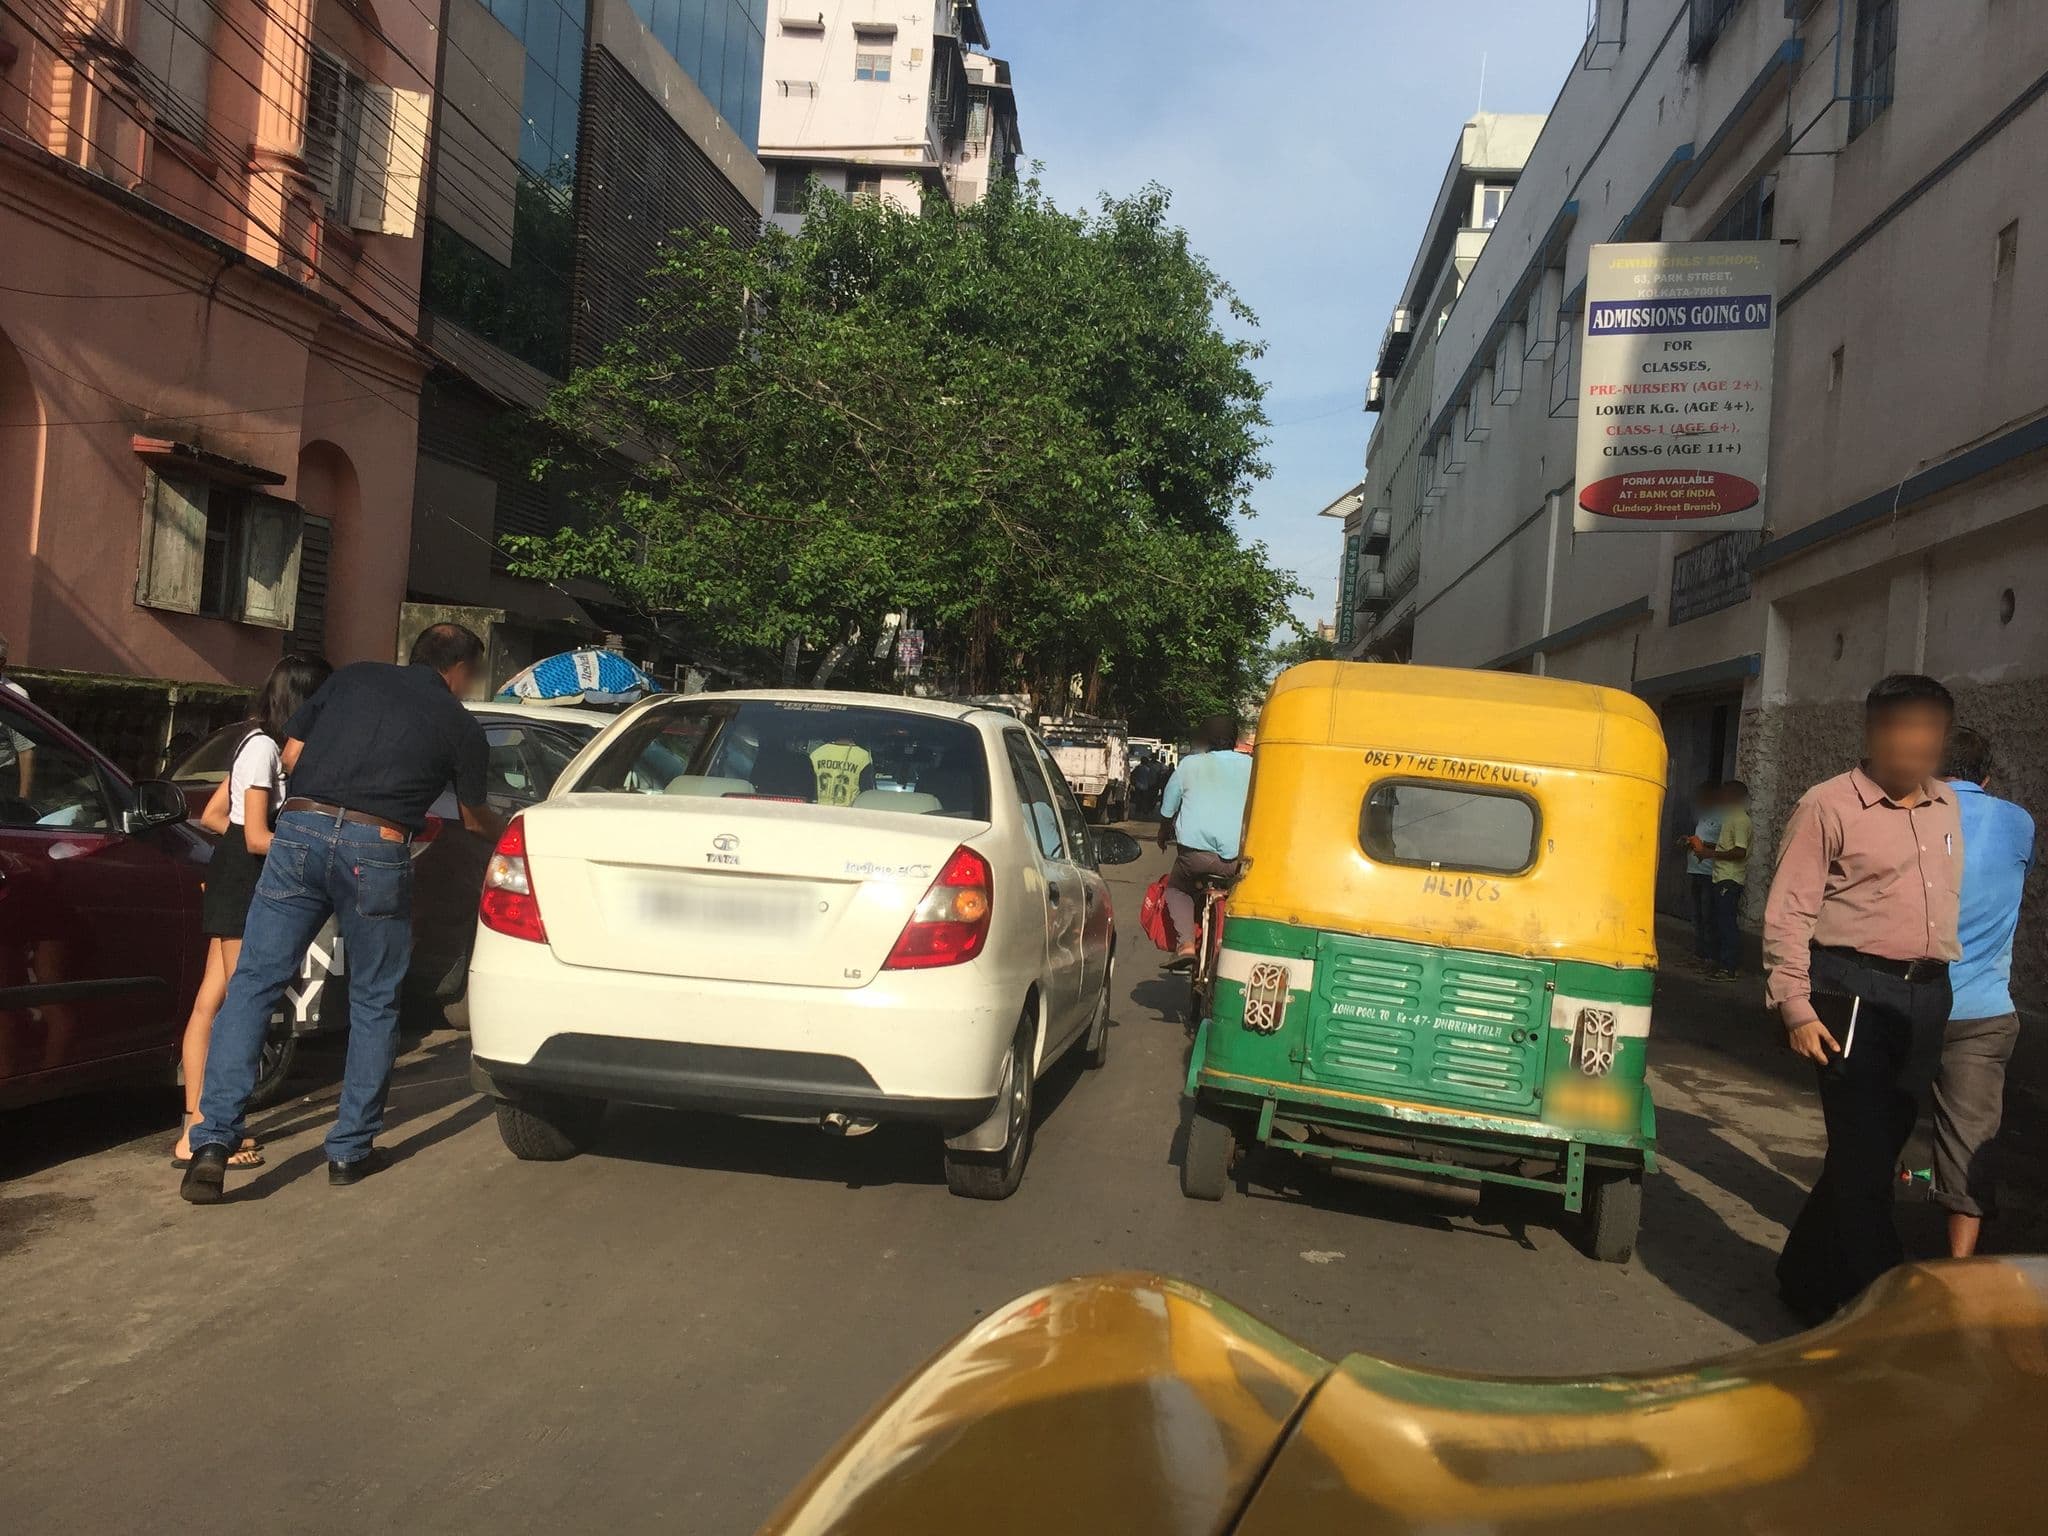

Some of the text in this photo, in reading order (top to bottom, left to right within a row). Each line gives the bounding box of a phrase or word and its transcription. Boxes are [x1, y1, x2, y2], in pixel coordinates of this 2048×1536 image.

[1654, 273, 1684, 284] PARK
[1592, 302, 1767, 329] ADMISSIONS GOING ON
[1663, 340, 1693, 352] FOR
[1642, 360, 1712, 373] CLASSES,
[1589, 382, 1690, 396] PRE-NURSERY
[1692, 381, 1728, 394] (AGE
[1596, 400, 1755, 416] LOWER K.G. (AGE 4+),
[1606, 424, 1665, 436] CLASS-1
[1670, 422, 1706, 436] (AGE
[1602, 442, 1743, 457] CLASS-6 (AGE 11+)
[1622, 475, 1715, 486] FORMS AVAILABLE
[1639, 489, 1668, 499] BANK
[1670, 489, 1685, 499] OF
[1686, 488, 1716, 498] INDIA
[1612, 501, 1722, 514] (Lindsay Street Branch)
[817, 759, 860, 775] BROOKLYN
[1364, 751, 1401, 769] OBEY
[1407, 754, 1438, 772] THE
[1442, 759, 1490, 779] TRAFIC
[706, 853, 738, 865] TATA
[1379, 1009, 1390, 1020] TO
